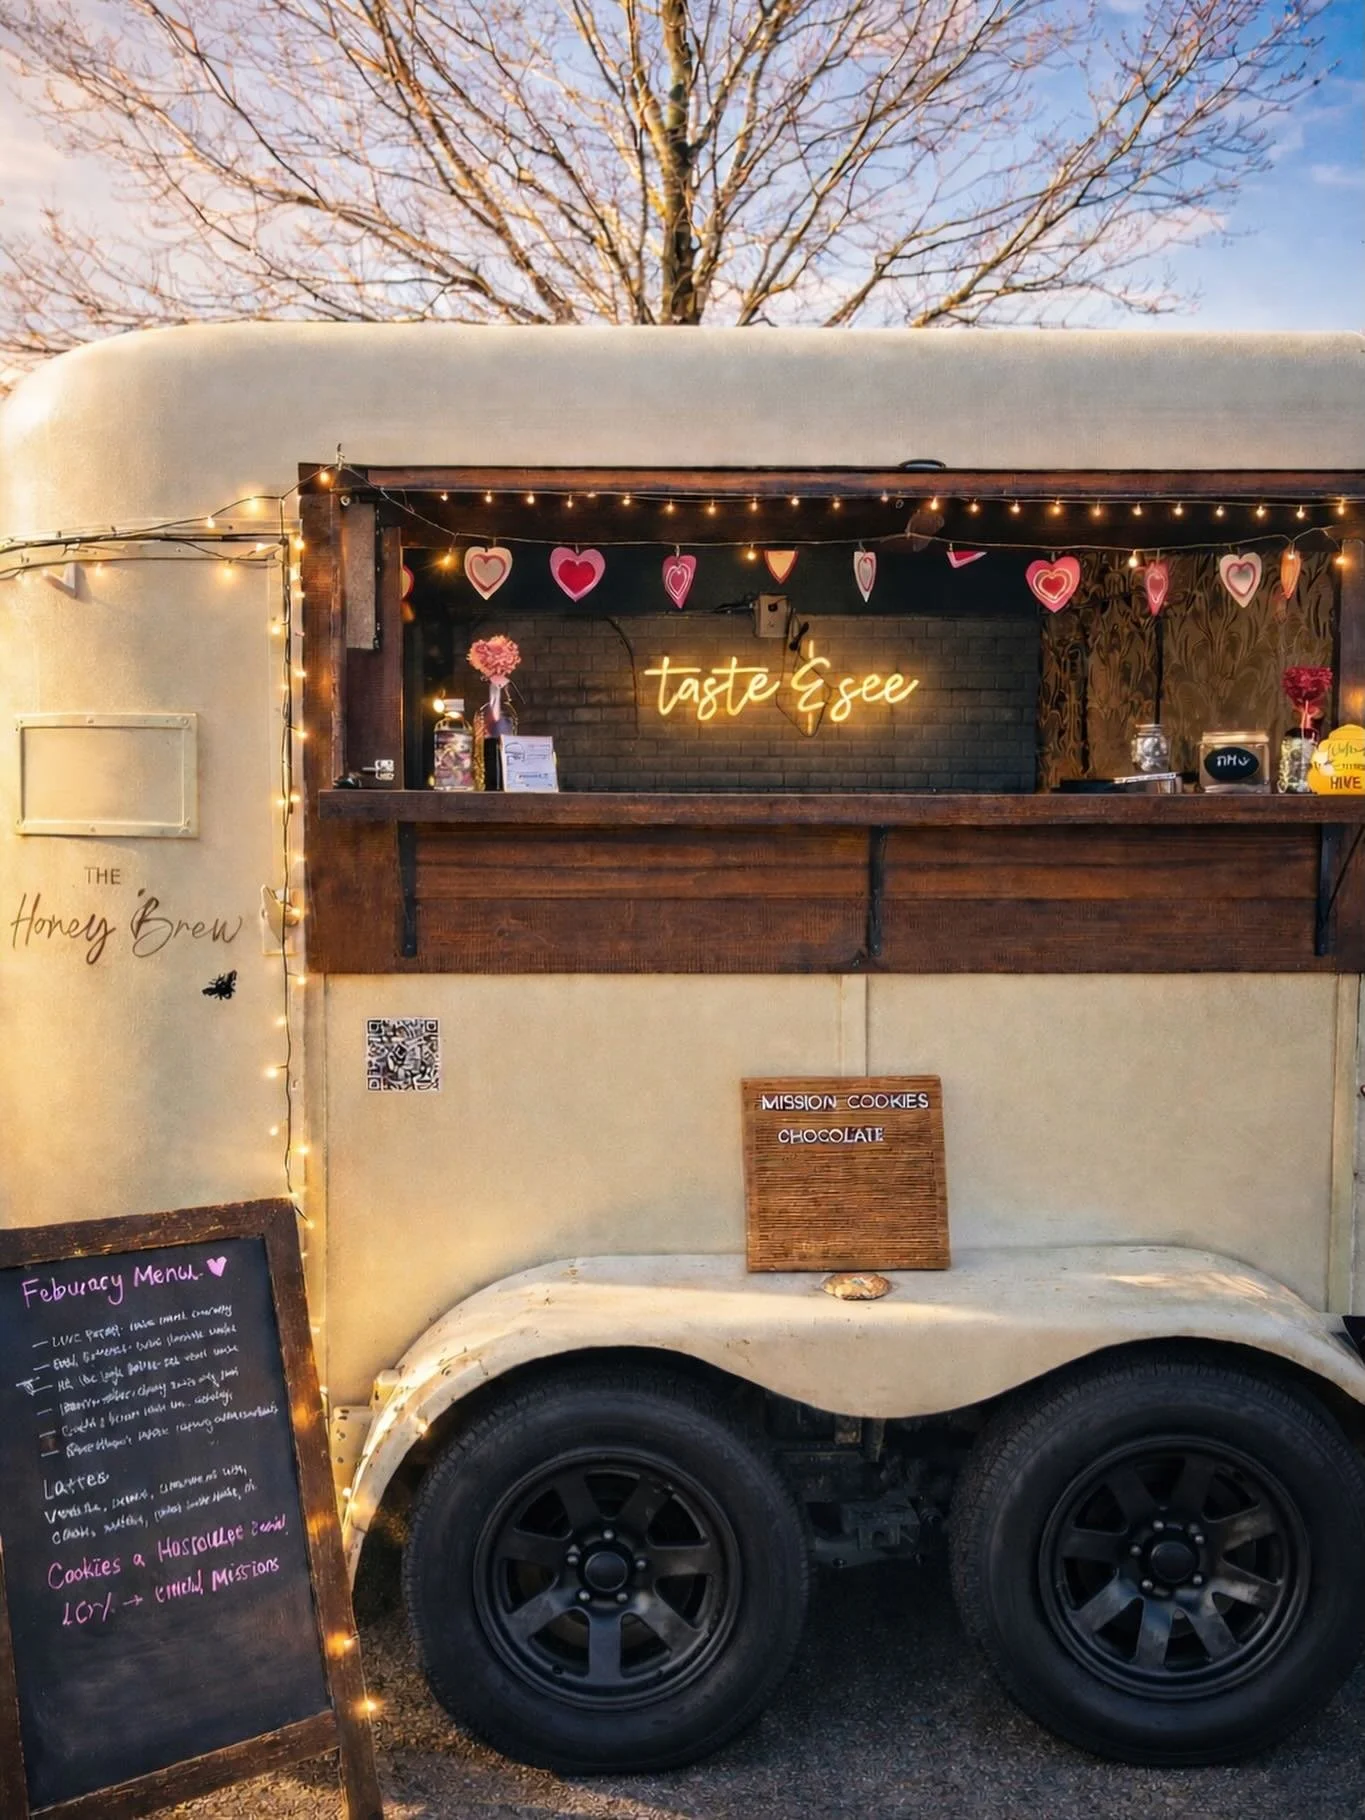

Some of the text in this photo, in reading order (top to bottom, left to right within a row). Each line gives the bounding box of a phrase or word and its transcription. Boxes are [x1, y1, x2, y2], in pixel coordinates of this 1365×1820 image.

[644, 656, 781, 720] taste
[830, 672, 920, 722] see
[1330, 776, 1362, 790] HIVE
[84, 867, 121, 885] THE
[11, 888, 243, 965] Honey Brew
[761, 1093, 929, 1111] MISSION COOKIES
[777, 1127, 884, 1145] CHOCOLATE
[133, 1264, 202, 1288] Menu
[48, 1557, 121, 1589] Cookies
[212, 1557, 279, 1592] Missions
